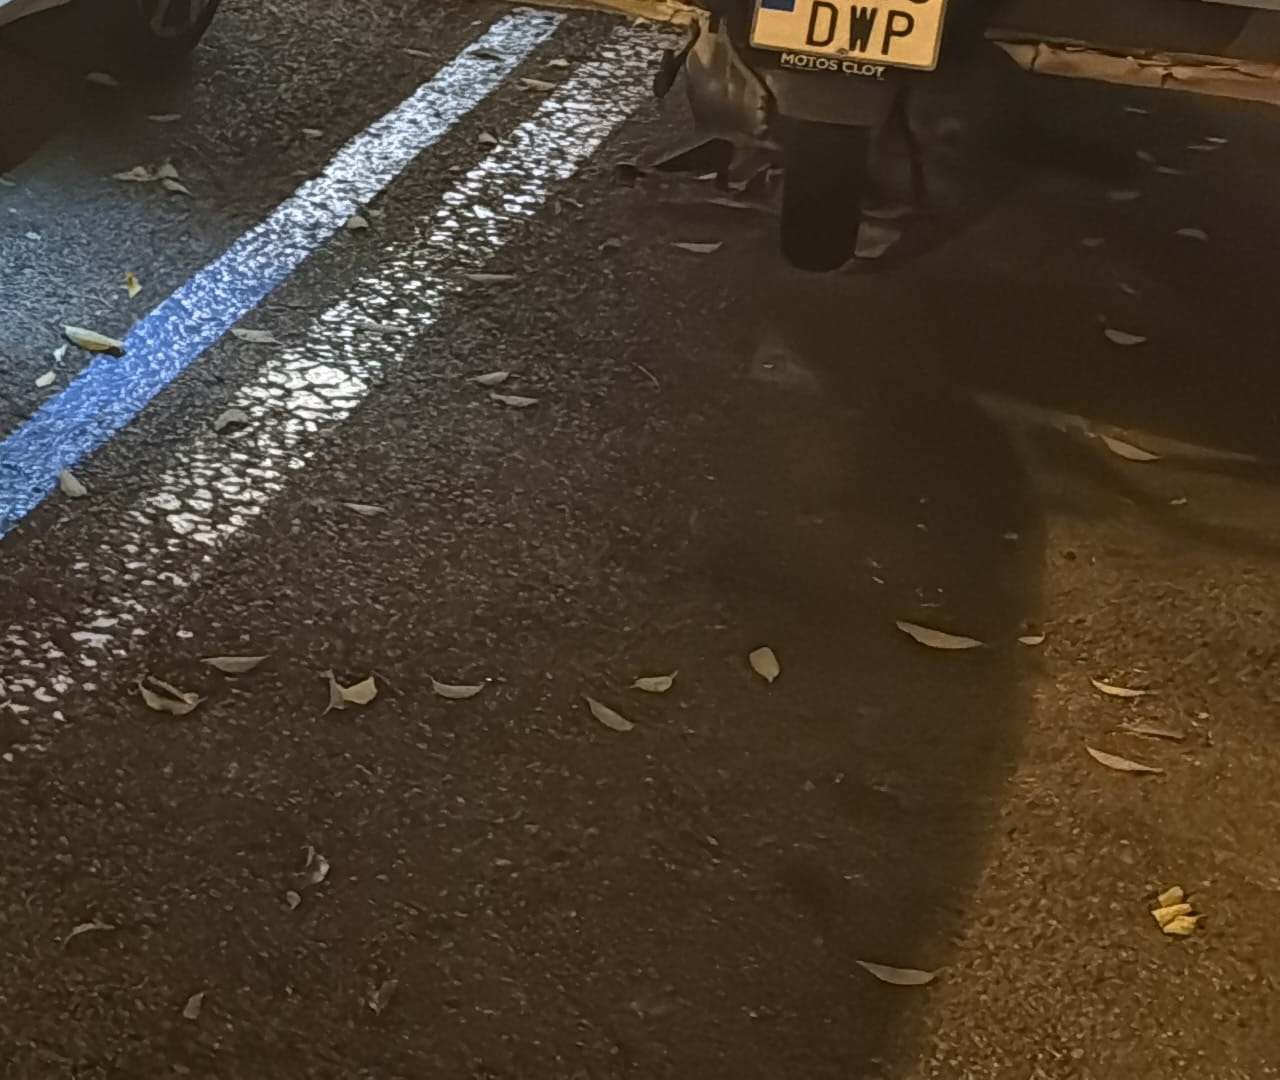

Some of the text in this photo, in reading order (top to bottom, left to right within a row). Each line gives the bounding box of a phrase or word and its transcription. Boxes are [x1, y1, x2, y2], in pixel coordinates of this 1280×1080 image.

[805, 0, 916, 56] DWP
[780, 52, 839, 71] MOTOS
[842, 61, 887, 78] CLOT
